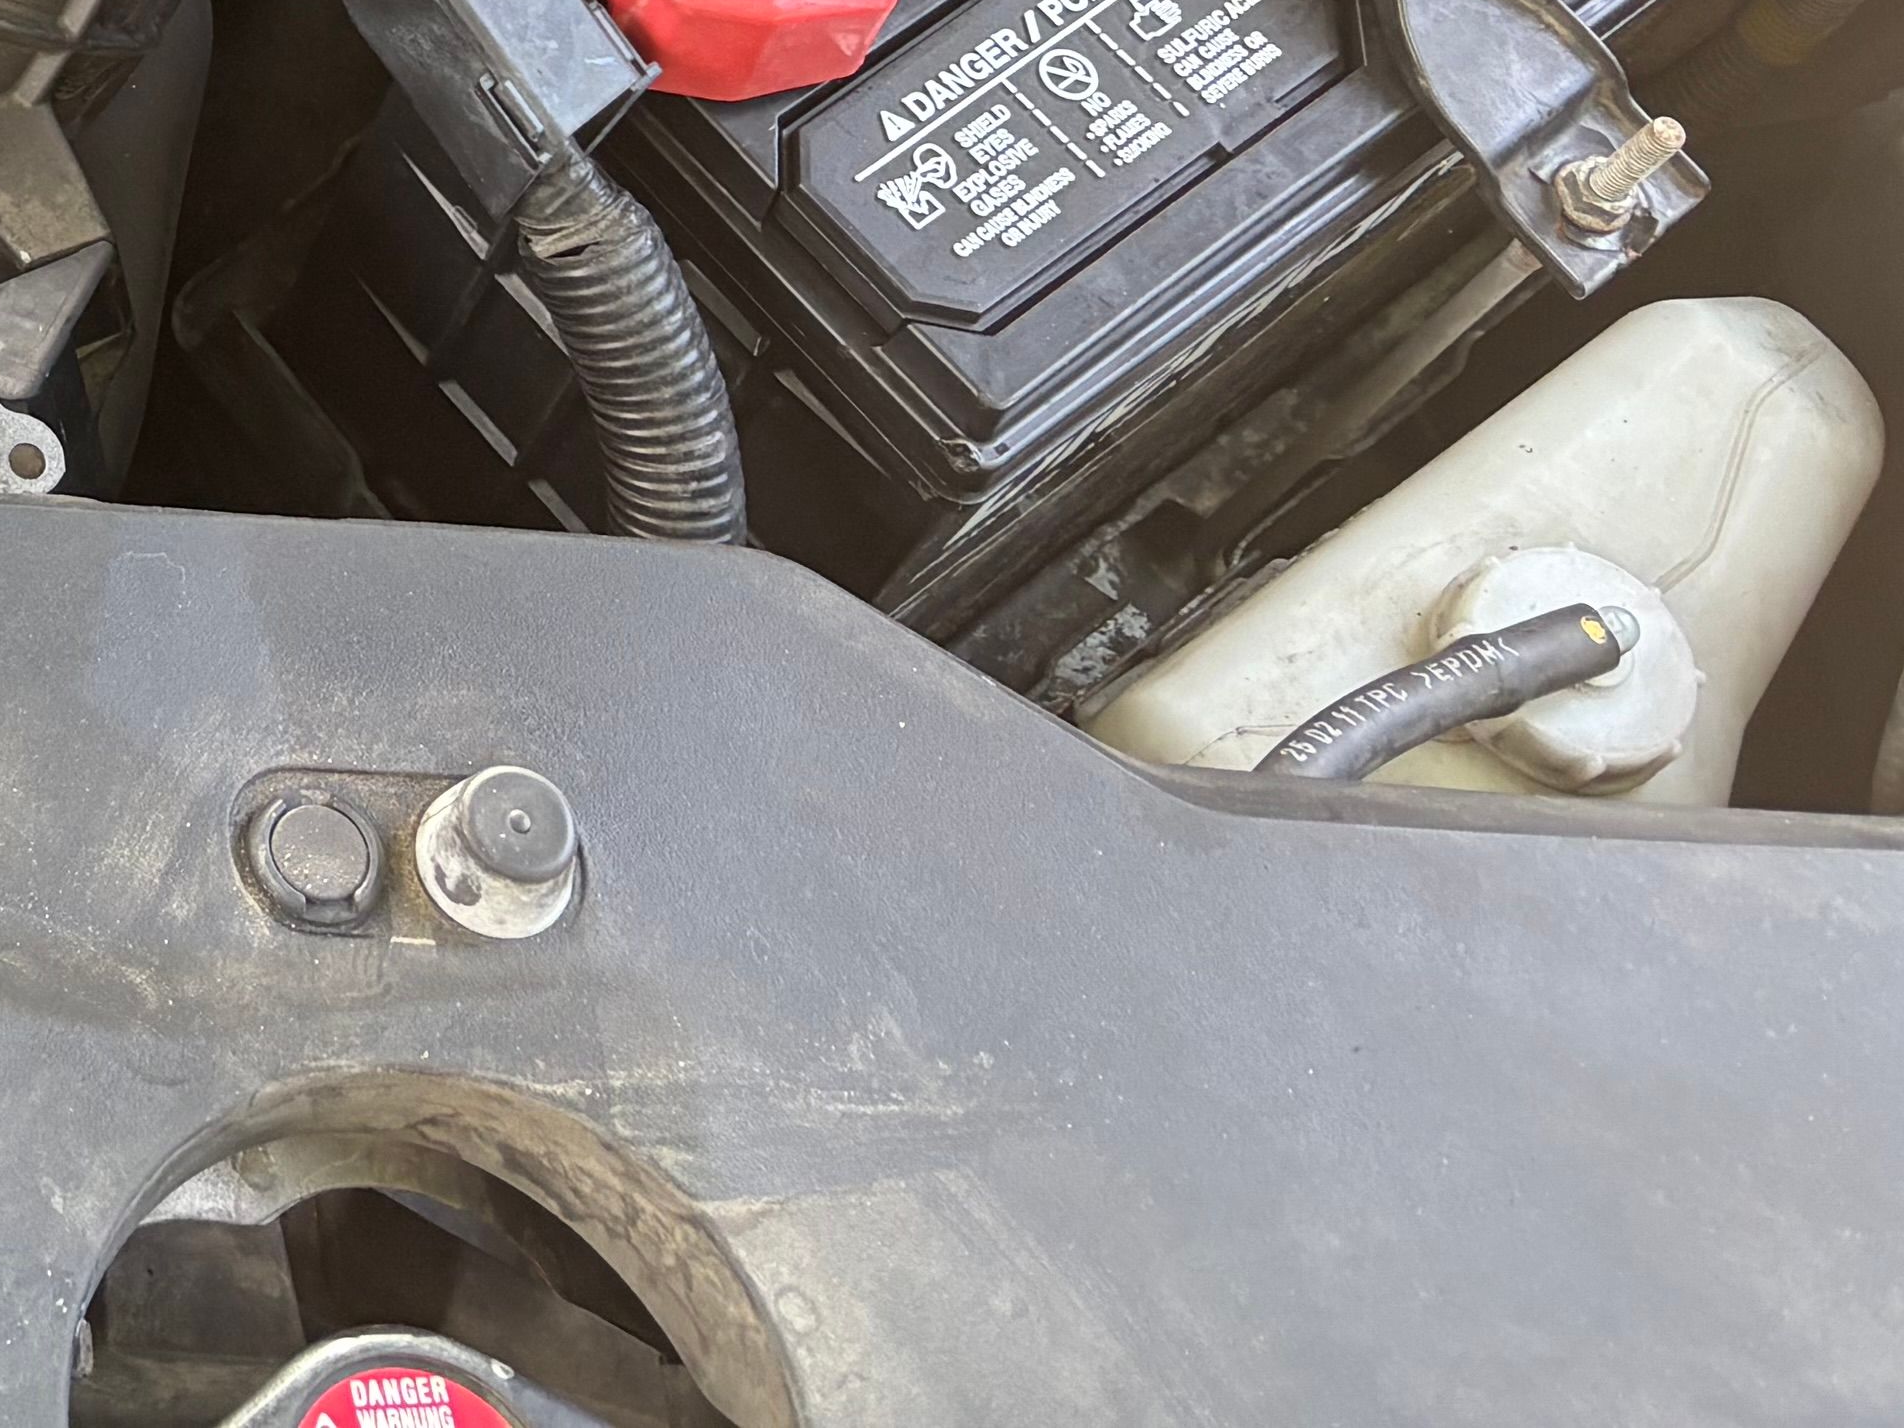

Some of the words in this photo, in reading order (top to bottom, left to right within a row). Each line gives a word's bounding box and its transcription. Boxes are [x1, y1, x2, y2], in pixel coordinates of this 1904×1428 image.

[1157, 8, 1230, 64] SULFURIC
[1173, 52, 1204, 77] CAN
[1196, 28, 1239, 65] CAUSE
[901, 28, 1028, 122] DANGER
[1185, 43, 1250, 91] BLINDNESS
[1243, 30, 1269, 50] OR
[1200, 64, 1246, 105] SEVERE
[1239, 43, 1283, 78] BURNS
[954, 103, 1011, 149] SHIELD
[1081, 91, 1112, 117] NO
[953, 138, 1039, 203] EXPLOSIVE
[968, 128, 1016, 166] EYES
[953, 228, 984, 257] CAN
[978, 203, 1020, 245] CAUSE
[1014, 167, 1075, 224] BLINDNESS
[970, 175, 1027, 217] GASES
[1001, 226, 1023, 247] OR
[1017, 200, 1062, 239] INJURY
[1354, 681, 1409, 713] TPC
[349, 1375, 450, 1407] DANGER
[354, 1405, 457, 1428] WARNUNG
